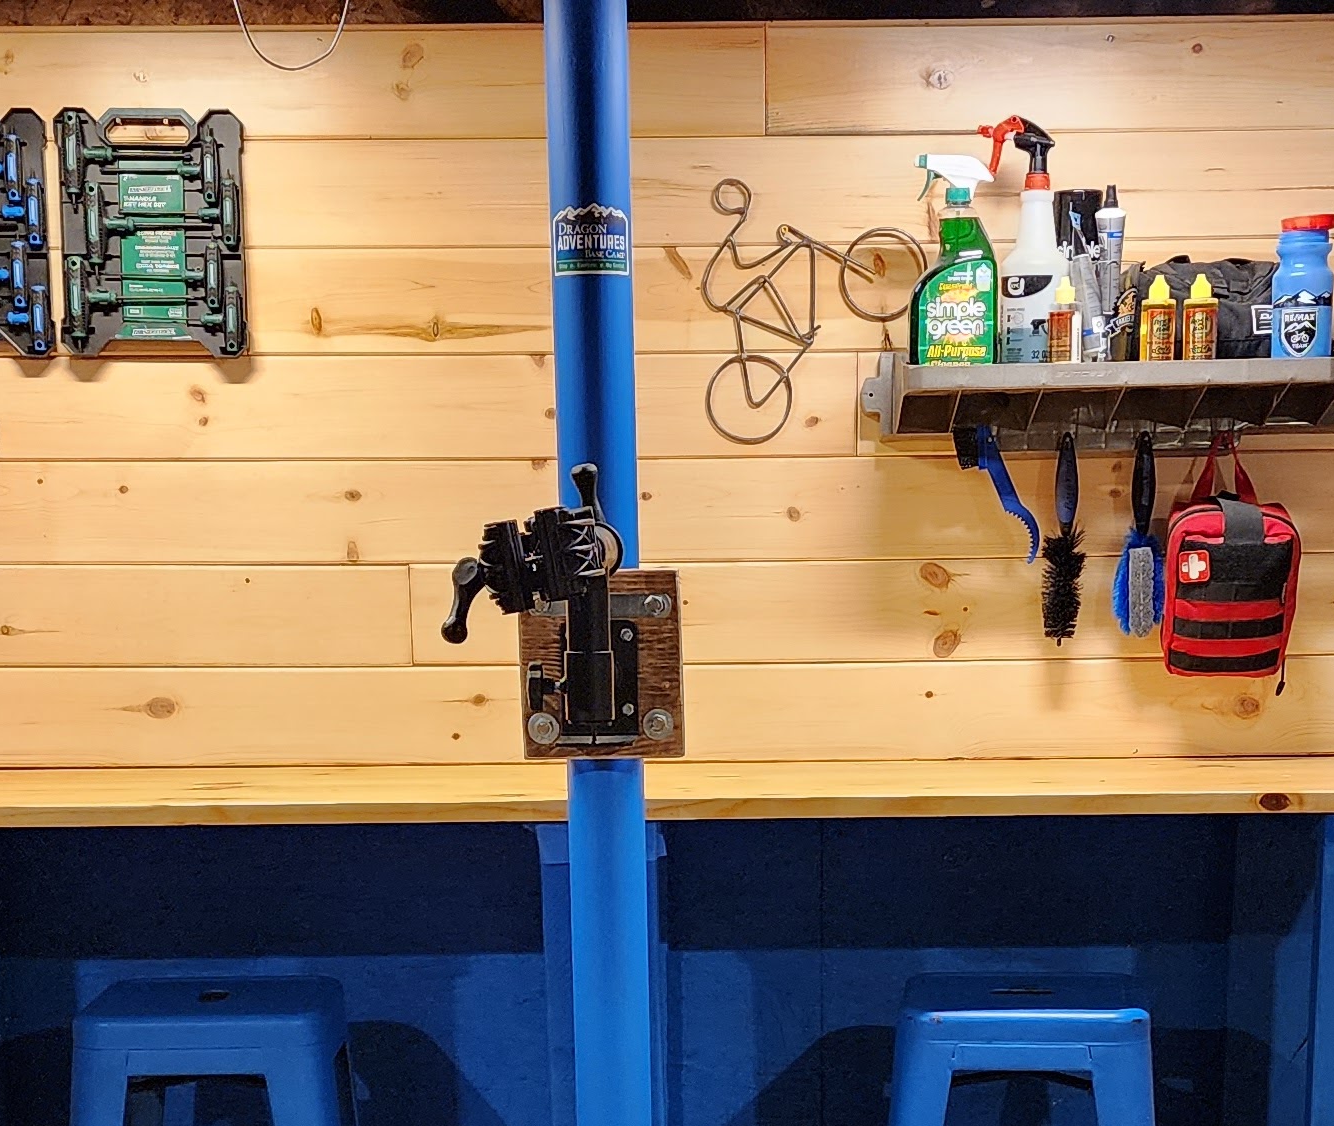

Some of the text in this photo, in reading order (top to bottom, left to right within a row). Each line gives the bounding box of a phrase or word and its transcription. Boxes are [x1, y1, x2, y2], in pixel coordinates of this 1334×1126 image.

[557, 235, 625, 251] ADVENTURES
[926, 296, 986, 321] simple
[928, 318, 984, 340] green
[927, 344, 987, 359] All-Purpose
[1031, 349, 1042, 360] 32
